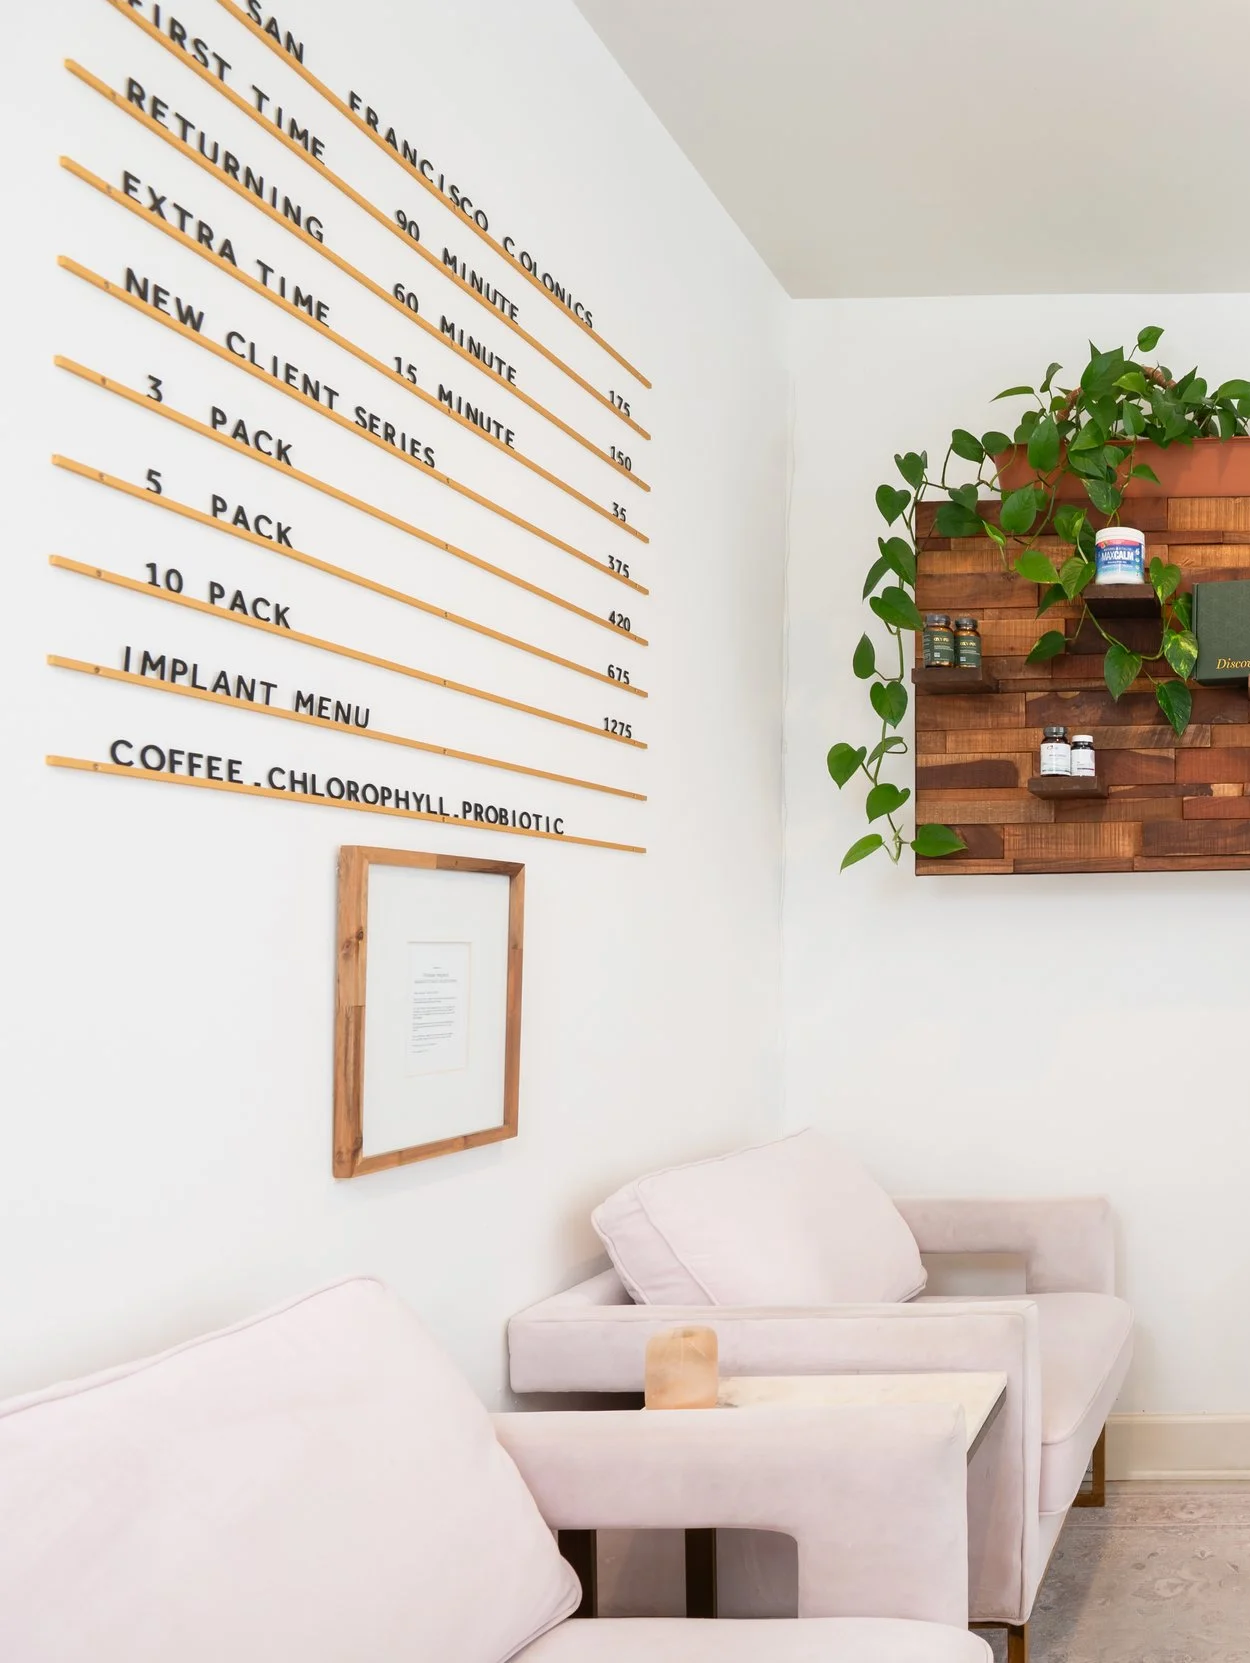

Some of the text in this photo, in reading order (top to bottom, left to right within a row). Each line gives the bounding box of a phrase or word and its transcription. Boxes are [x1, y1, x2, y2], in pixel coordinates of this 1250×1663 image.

[127, 0, 631, 418] IRST TIME 90 MINUTE 175
[127, 77, 632, 472] RETURNING 60 MINUTE 150
[247, 0, 593, 329] SAN FRANCISCO COLONICS
[123, 170, 627, 523] EXTRA TIME 15 MINUTE 35
[125, 267, 630, 579] NEW CLIENT SERIES 375
[146, 374, 631, 632] 3 PACK 420
[146, 468, 630, 685] 5 PACK 675
[1101, 550, 1134, 561] MAXCALM
[123, 645, 370, 729] IMPLANT MENU
[146, 562, 632, 739] 10 PACK 1275
